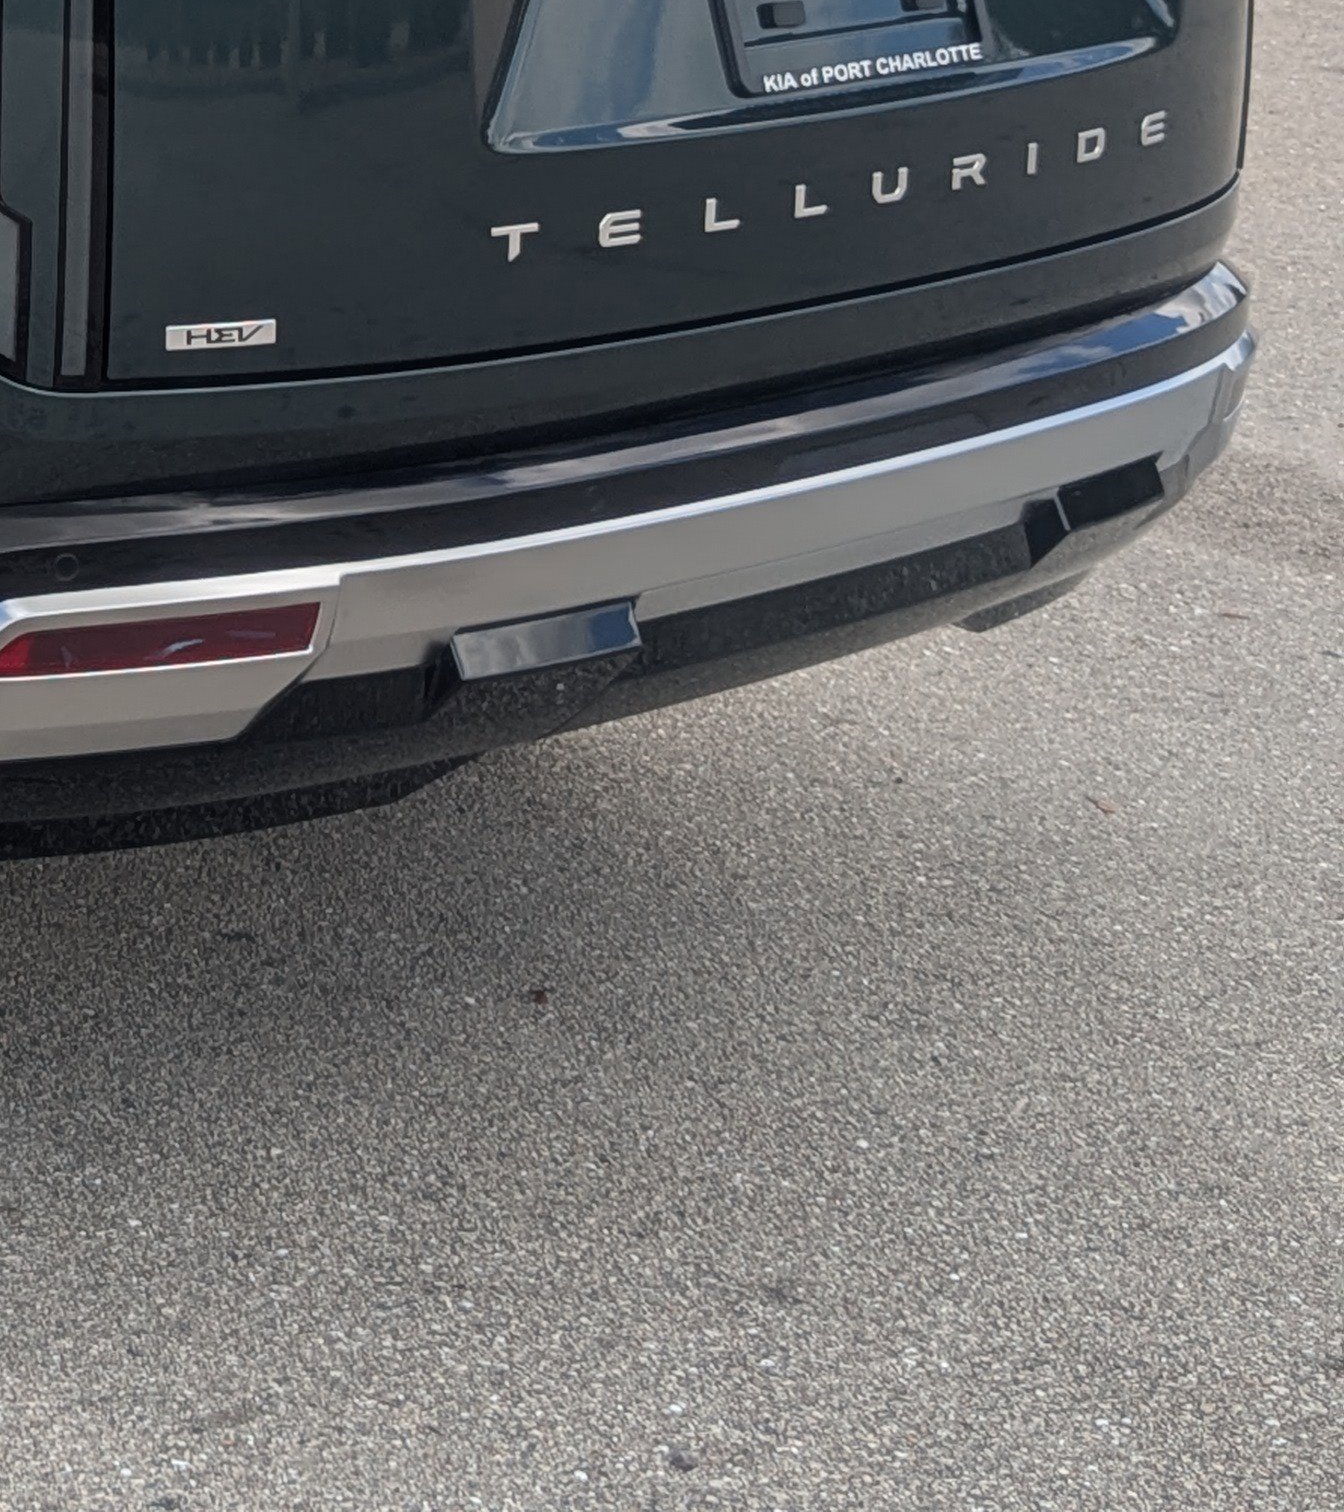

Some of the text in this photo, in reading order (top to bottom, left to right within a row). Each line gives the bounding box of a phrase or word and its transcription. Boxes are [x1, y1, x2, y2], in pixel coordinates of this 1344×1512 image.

[763, 42, 983, 93] KIA of PORT CHARLOTTE
[490, 110, 1169, 262] TELLURIDE
[186, 324, 263, 345] HEV
